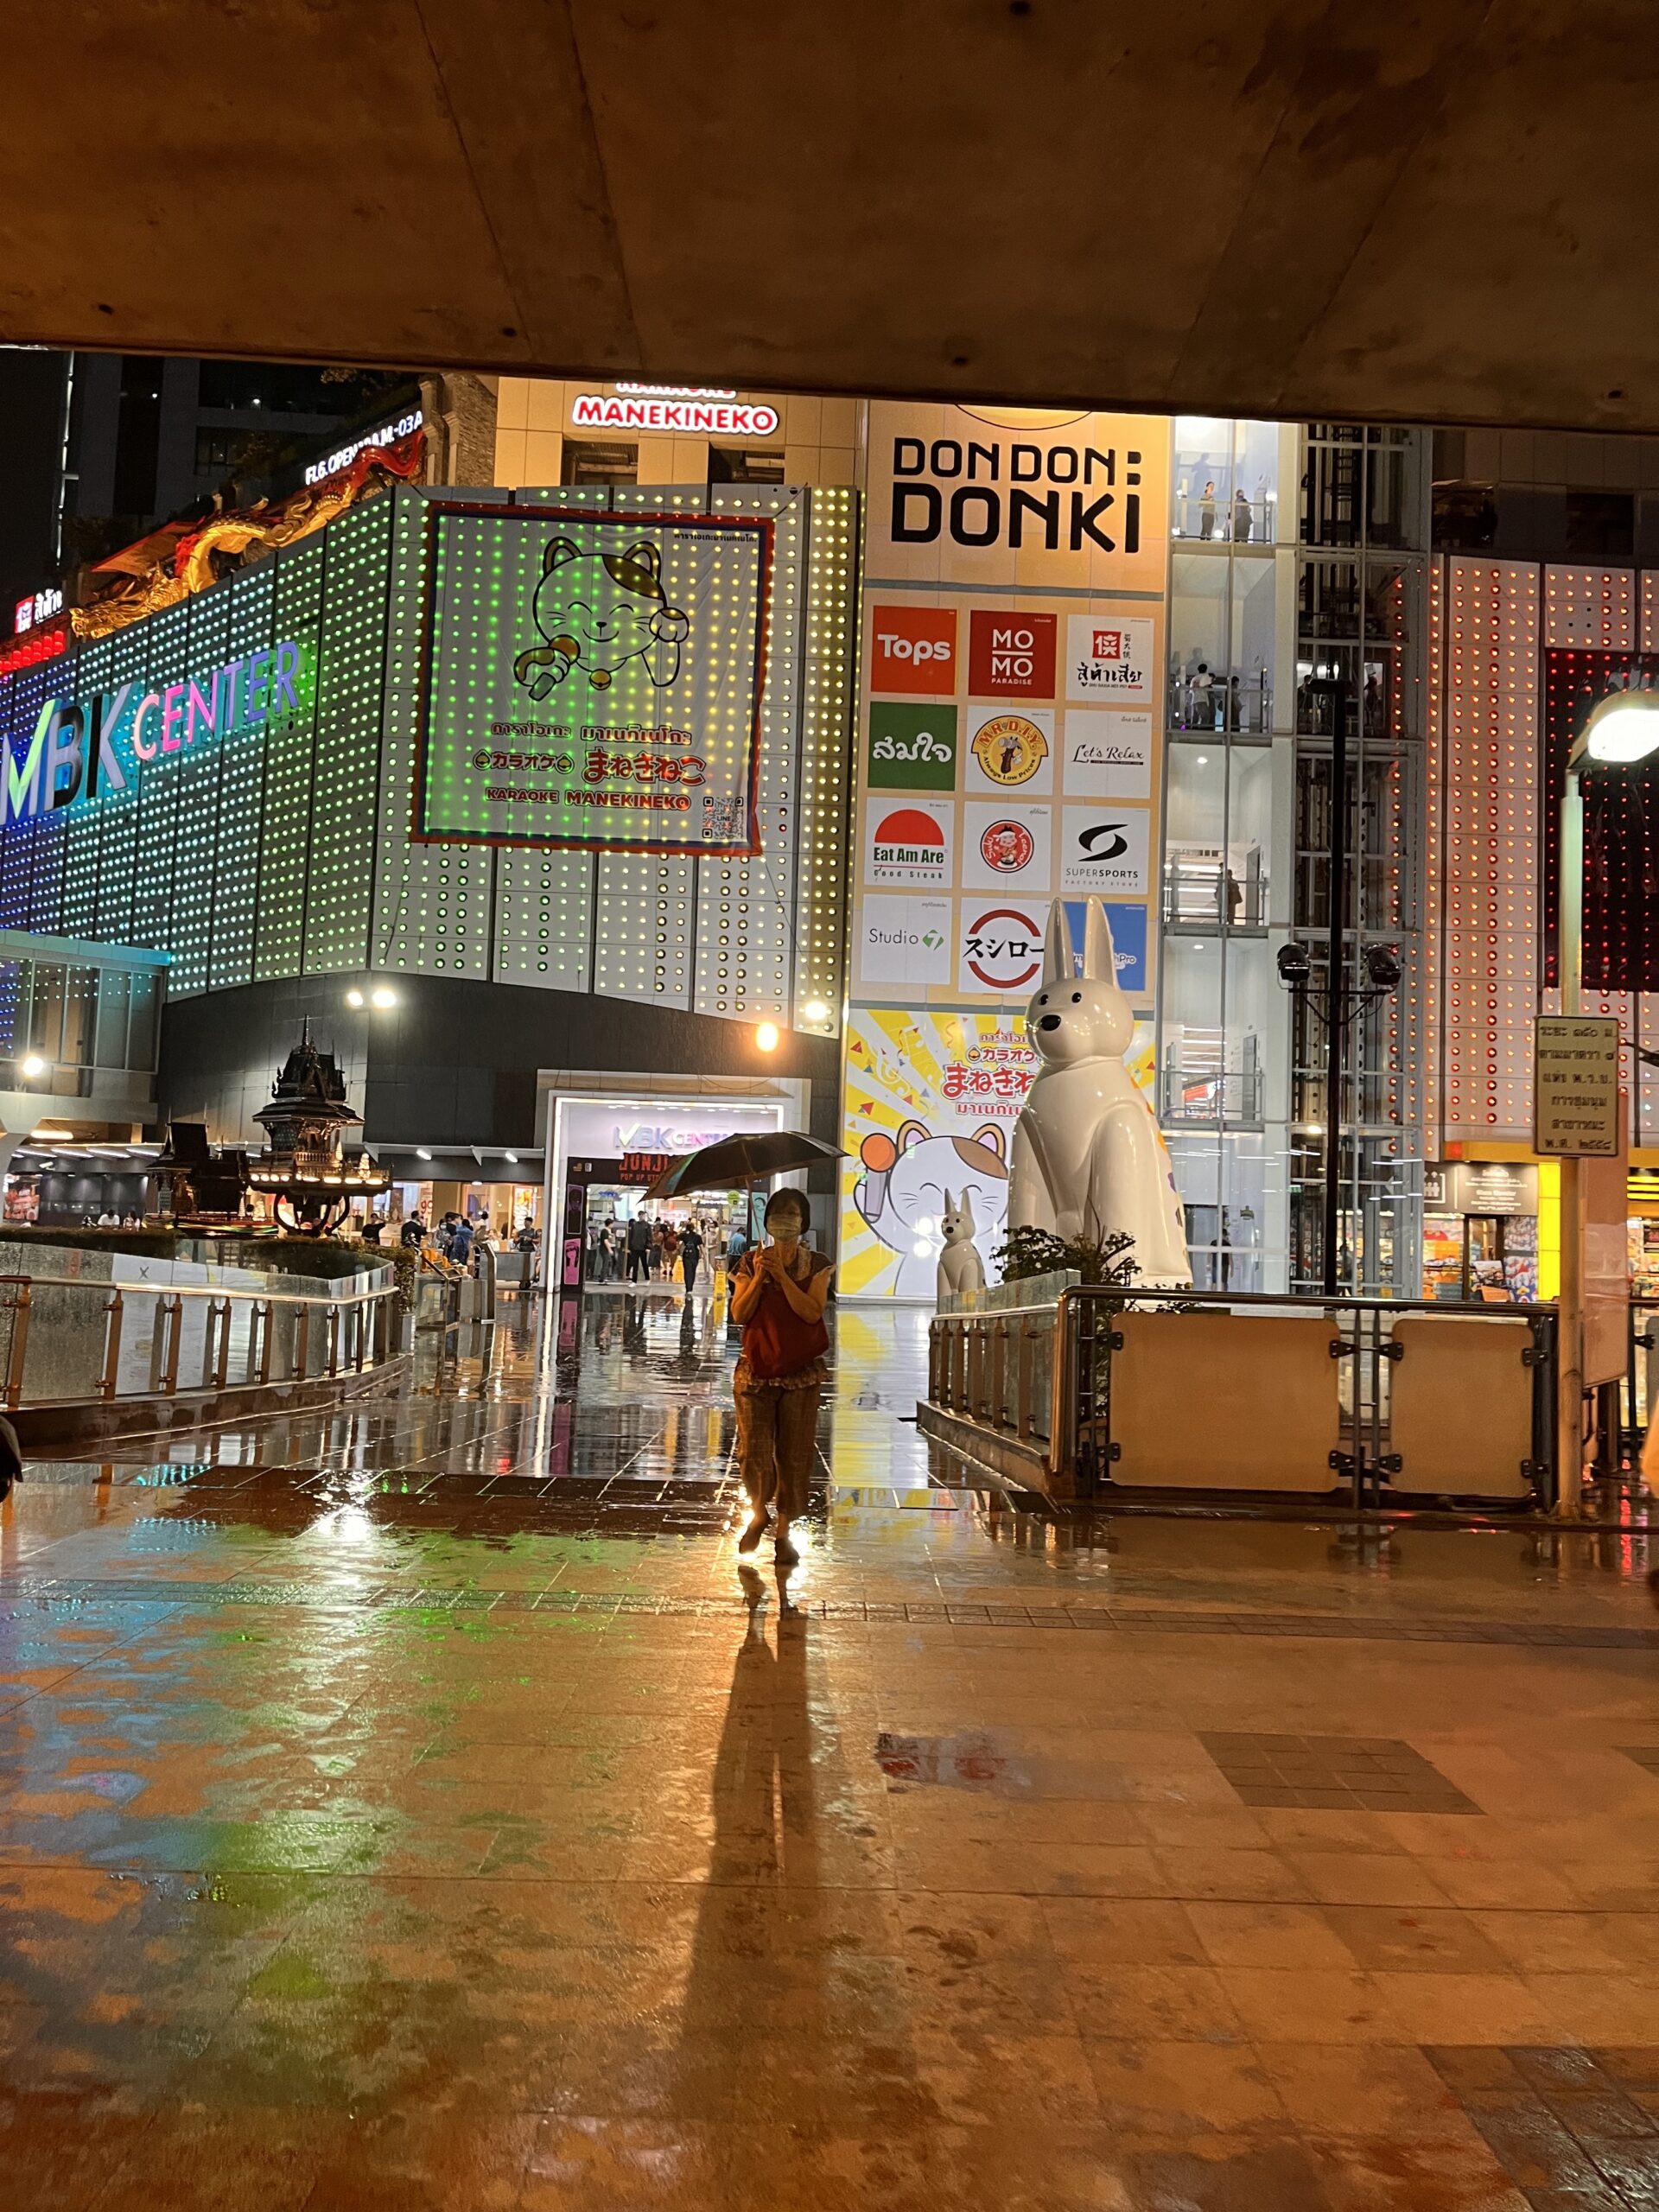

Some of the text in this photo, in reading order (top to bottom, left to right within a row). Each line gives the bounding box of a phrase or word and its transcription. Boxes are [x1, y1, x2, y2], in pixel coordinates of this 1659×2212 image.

[577, 400, 773, 430] MANEKINEKO
[893, 437, 1116, 486] DON DON
[877, 634, 950, 665] Tops
[993, 629, 1034, 649] MO
[991, 658, 1033, 677] MO
[0, 641, 299, 823] MBK CENTER
[873, 732, 952, 763] สมใจ
[1071, 744, 1144, 763] Let's Relax
[493, 748, 706, 785] カラオケ まねきねこ
[983, 756, 1001, 778] Always
[1018, 759, 1035, 778] Prices
[487, 790, 690, 810] KARAOKE MANEKINEKO
[874, 847, 944, 863] Eat Am Are
[874, 868, 901, 877] Good
[1065, 868, 1138, 879] SUPERSPORTS
[869, 928, 918, 945] Studio
[963, 938, 1045, 959] スシロー
[615, 1123, 673, 1148] MBK
